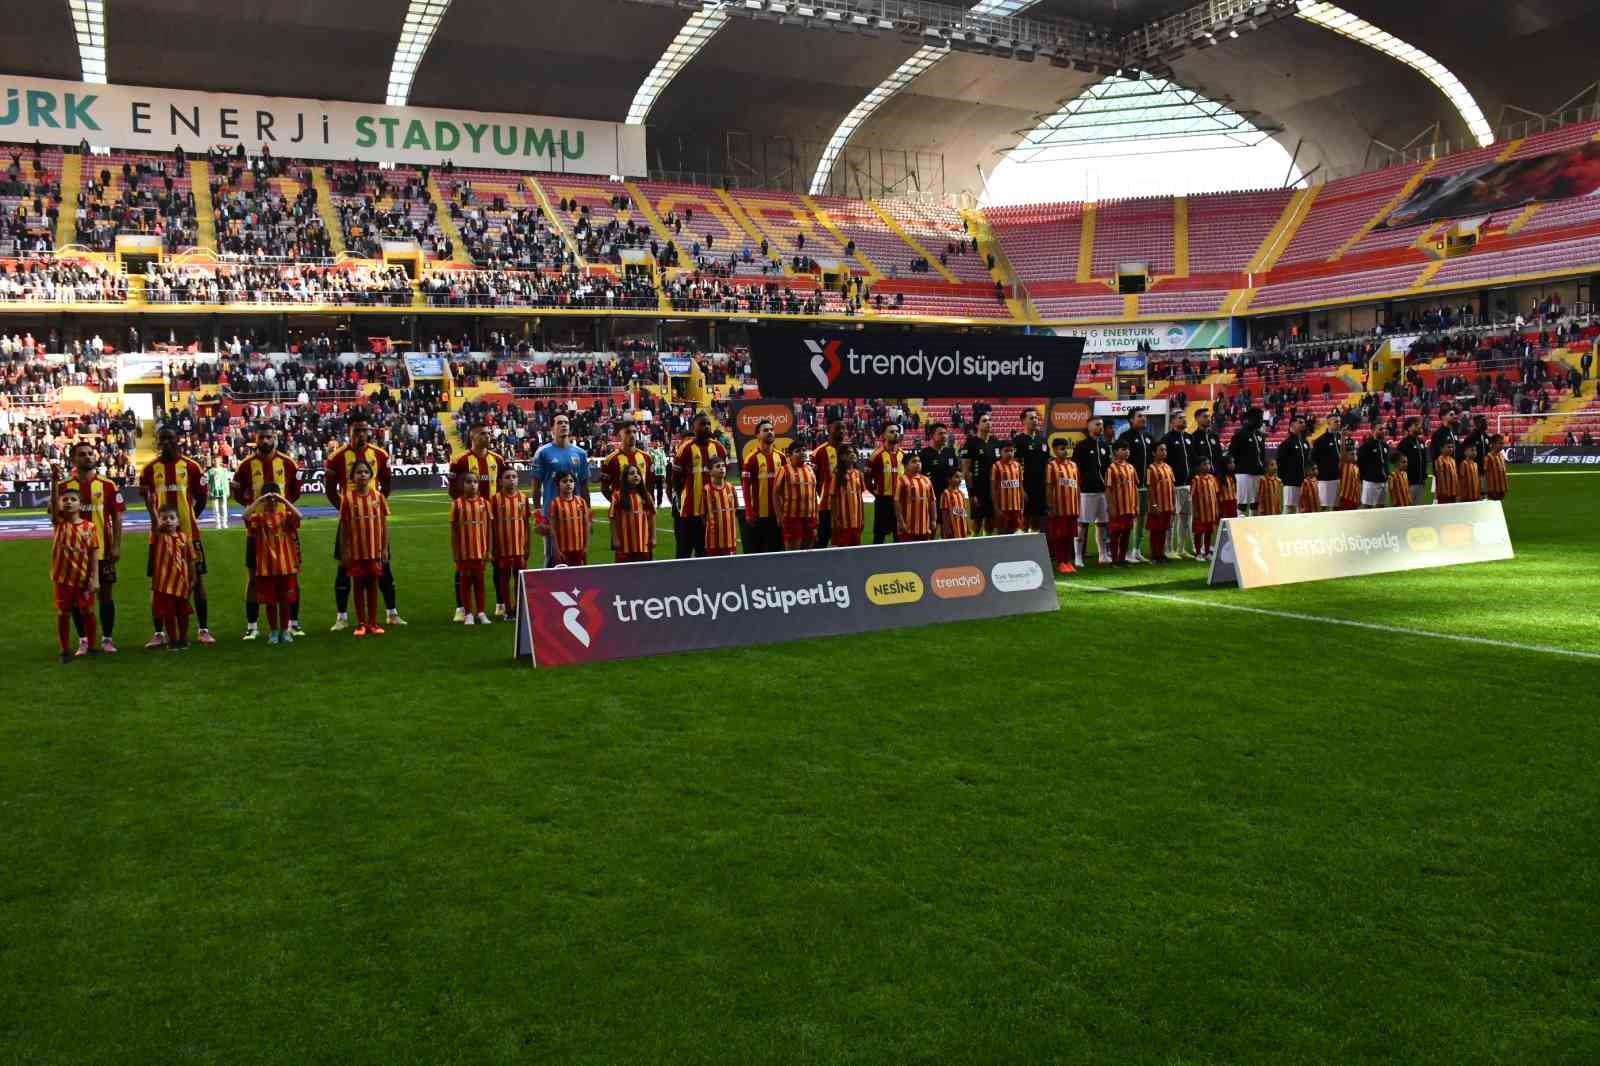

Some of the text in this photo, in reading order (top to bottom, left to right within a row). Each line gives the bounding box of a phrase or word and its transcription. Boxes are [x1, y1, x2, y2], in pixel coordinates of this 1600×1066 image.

[355, 115, 585, 160] STADYUMU
[847, 348, 1044, 382] trendyol SüperLig
[612, 583, 749, 623] trendyol
[751, 580, 850, 614] SüperLig
[936, 574, 981, 589] trendyol
